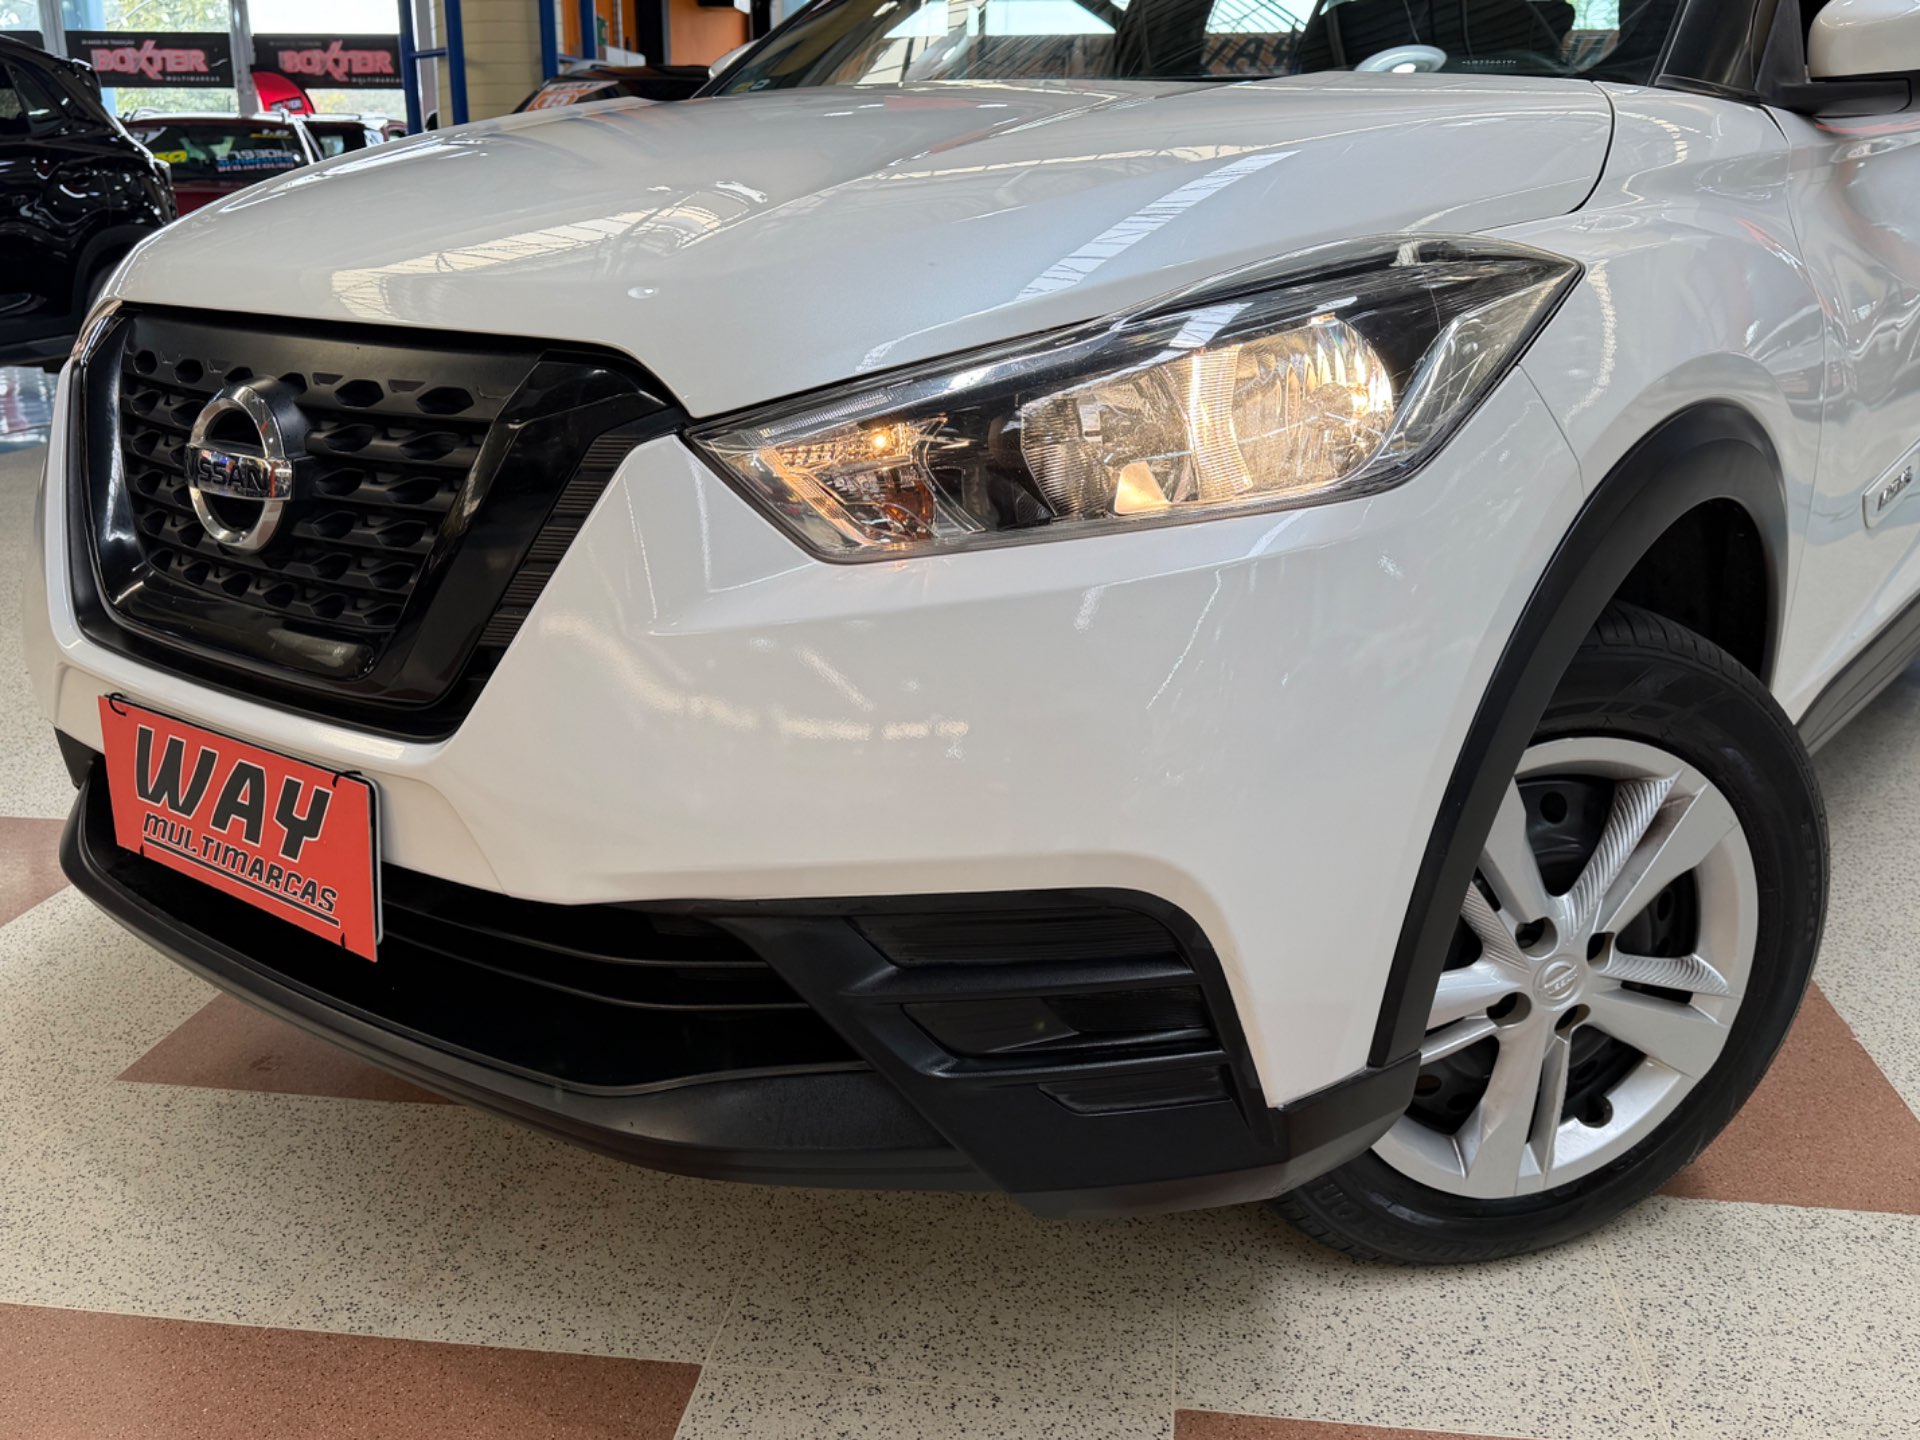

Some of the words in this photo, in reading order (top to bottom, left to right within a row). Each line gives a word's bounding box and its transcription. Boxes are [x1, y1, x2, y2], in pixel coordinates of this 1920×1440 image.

[91, 39, 209, 80] BOXTER
[278, 39, 395, 82] BOXTER
[134, 724, 333, 863] WAY
